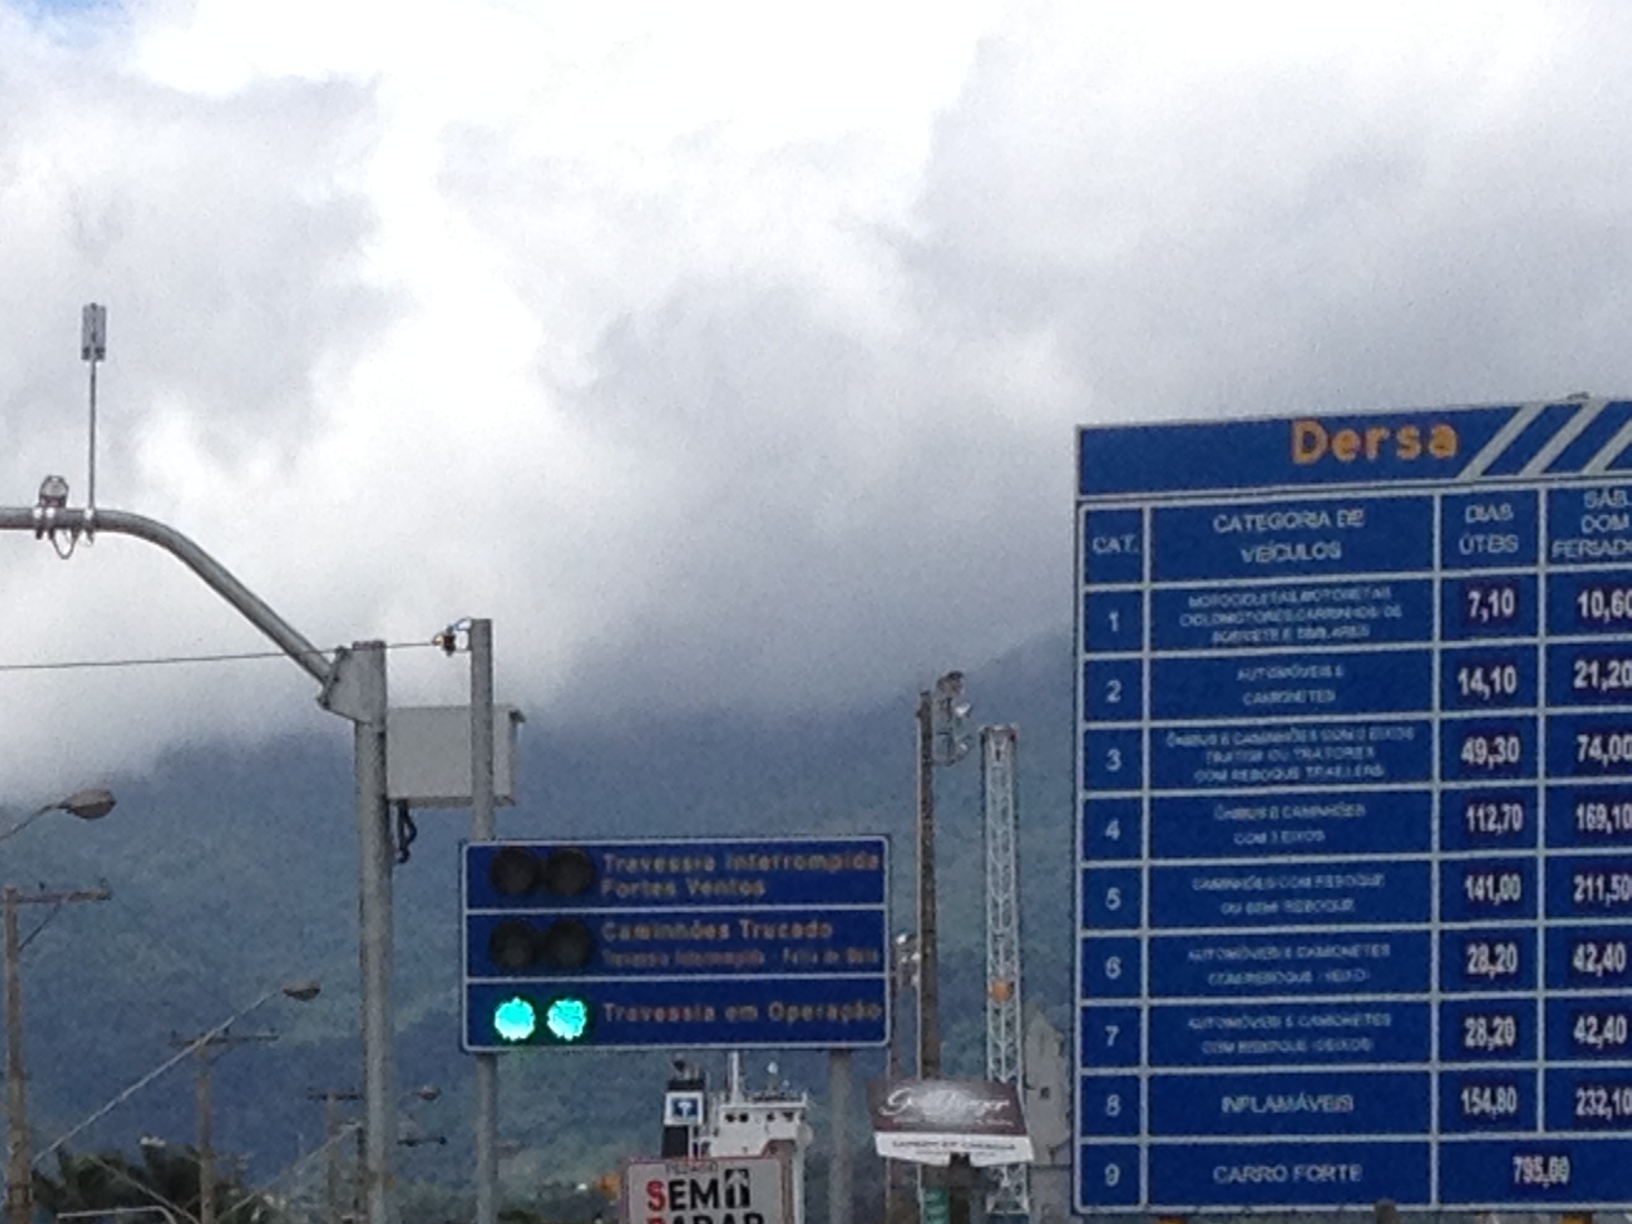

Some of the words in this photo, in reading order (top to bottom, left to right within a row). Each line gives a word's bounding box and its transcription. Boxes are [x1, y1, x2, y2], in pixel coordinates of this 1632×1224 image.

[1292, 418, 1458, 465] Dersa
[1213, 511, 1330, 533] CATEGORIA
[1336, 509, 1365, 528] DE
[1465, 503, 1514, 523] DIAS
[1092, 534, 1139, 555] CAT.
[1468, 588, 1515, 622] 7,10
[1108, 611, 1119, 632] 1
[1105, 679, 1122, 703] 2
[1458, 664, 1517, 700] 14,10
[1105, 748, 1122, 771] 3
[1461, 736, 1520, 770] 49,30
[1105, 818, 1121, 841] 4
[1466, 803, 1524, 835] 112,70
[1576, 803, 1632, 834] 169,10
[602, 853, 715, 873] Travessia
[600, 878, 677, 897] Fortes
[686, 877, 766, 897] Ventos
[1105, 887, 1121, 911] 5
[1465, 873, 1522, 905] 141,00
[1573, 873, 1632, 908] 211,50
[1105, 956, 1121, 979] 6
[1468, 942, 1517, 979] 28,20
[1573, 942, 1626, 977] 42,40
[603, 1003, 715, 1022] Travessia
[724, 1005, 758, 1022] em
[1104, 1025, 1120, 1047] 7
[1465, 1016, 1516, 1050] 28,20
[1574, 1015, 1627, 1049] 42,40
[1105, 1094, 1121, 1118] 8
[1461, 1086, 1517, 1120] 154,80
[1576, 1087, 1632, 1120] 232,10
[1104, 1163, 1120, 1187] 9
[1213, 1165, 1288, 1184] CARRO
[1293, 1163, 1363, 1183] FORTE
[646, 1178, 720, 1211] SEM
